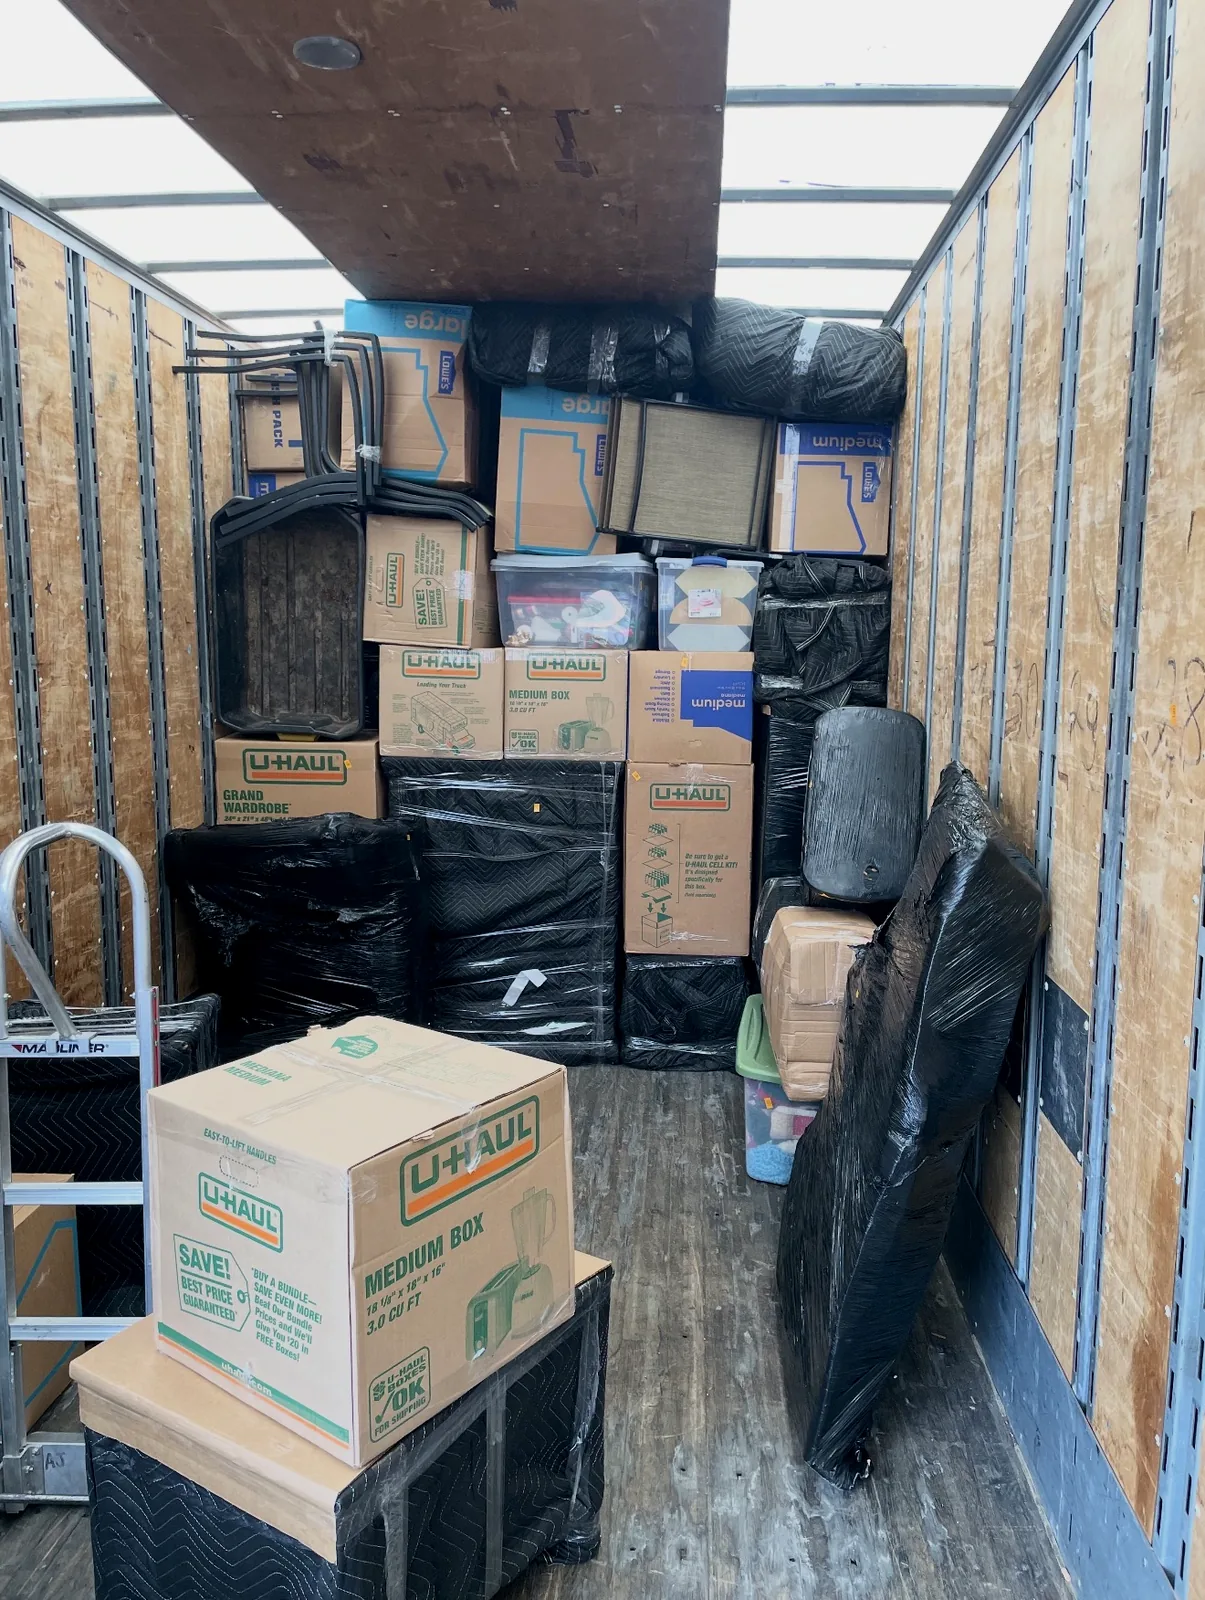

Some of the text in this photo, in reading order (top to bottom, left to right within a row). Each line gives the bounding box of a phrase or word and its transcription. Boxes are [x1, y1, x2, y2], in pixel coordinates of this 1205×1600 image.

[405, 310, 467, 341] large
[441, 355, 452, 390] LOWE'S
[273, 410, 283, 448] PACK
[813, 436, 883, 451] medium
[388, 557, 397, 604] U-HAUL
[416, 589, 427, 625] SAVE!
[408, 655, 476, 669] U-HAUL
[532, 657, 601, 670] U-HAUL
[508, 690, 570, 700] MEDIUM BOX
[692, 699, 745, 711] medium
[520, 740, 536, 748] OK
[250, 754, 340, 771] U-HAUL
[224, 790, 264, 801] GRAND
[224, 802, 290, 814] WARDROBE
[656, 788, 726, 800] U-HAUL
[223, 1066, 272, 1086] MEDIUM
[240, 1060, 292, 1082] MEDIANA
[204, 1128, 277, 1165] EASY-TO-LIFT HANDLES
[412, 1112, 532, 1194] U-HAUL
[204, 1181, 278, 1232] U-HAUL
[180, 1244, 230, 1280] SAVE!
[365, 1212, 484, 1299] MEDIUM BOX
[181, 1276, 233, 1306] BEST PRICE
[252, 1268, 269, 1283] BUY
[270, 1278, 276, 1288] A
[366, 1302, 378, 1316] 18
[398, 1288, 404, 1298] x
[406, 1276, 421, 1293] 18"
[423, 1274, 428, 1284] x
[432, 1262, 446, 1278] 16"
[183, 1293, 236, 1322] GUARANTEED
[254, 1282, 322, 1324] SAVE EVEN MORE!
[254, 1295, 313, 1332] Beat Our Bundle
[366, 1292, 422, 1336] 3.0 CU FT
[254, 1308, 313, 1344] Prices and We'll
[256, 1320, 271, 1334] Give
[272, 1328, 286, 1342] You
[301, 1342, 309, 1355] in
[256, 1332, 300, 1362] FREE Boxes!
[388, 1356, 426, 1384] U-HAUL
[388, 1363, 427, 1394] BOXES
[392, 1375, 426, 1412] OK
[374, 1396, 426, 1436] FOR SHIPPING
